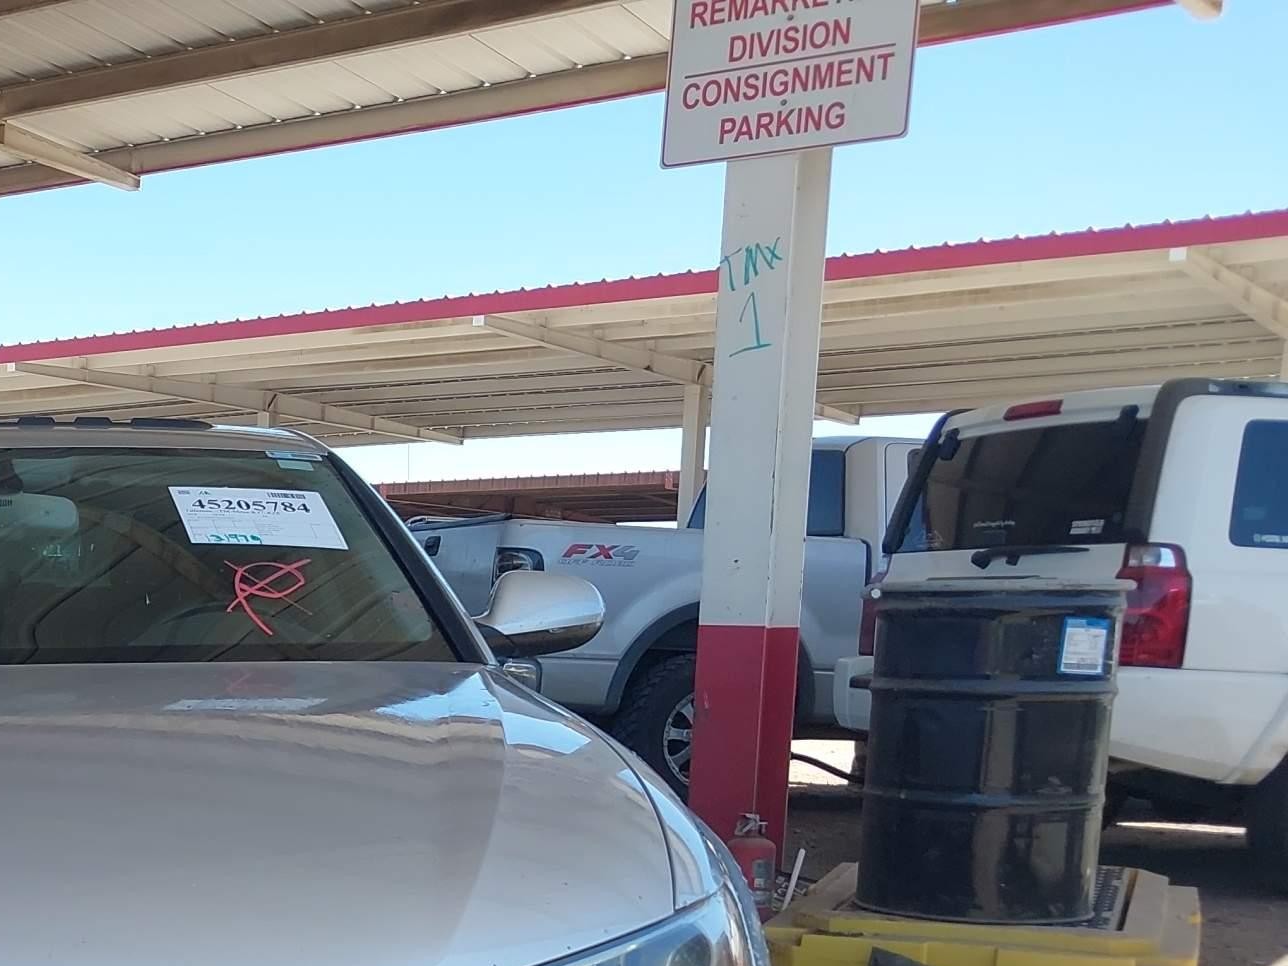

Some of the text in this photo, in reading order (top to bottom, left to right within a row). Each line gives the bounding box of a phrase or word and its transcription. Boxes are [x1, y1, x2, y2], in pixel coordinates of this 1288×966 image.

[728, 17, 852, 63] DIVISION
[682, 52, 896, 110] CONSIGNMENT
[718, 101, 846, 145] PARKING
[728, 291, 772, 358] 1
[191, 498, 311, 514] 45205784
[562, 543, 640, 561] FX4
